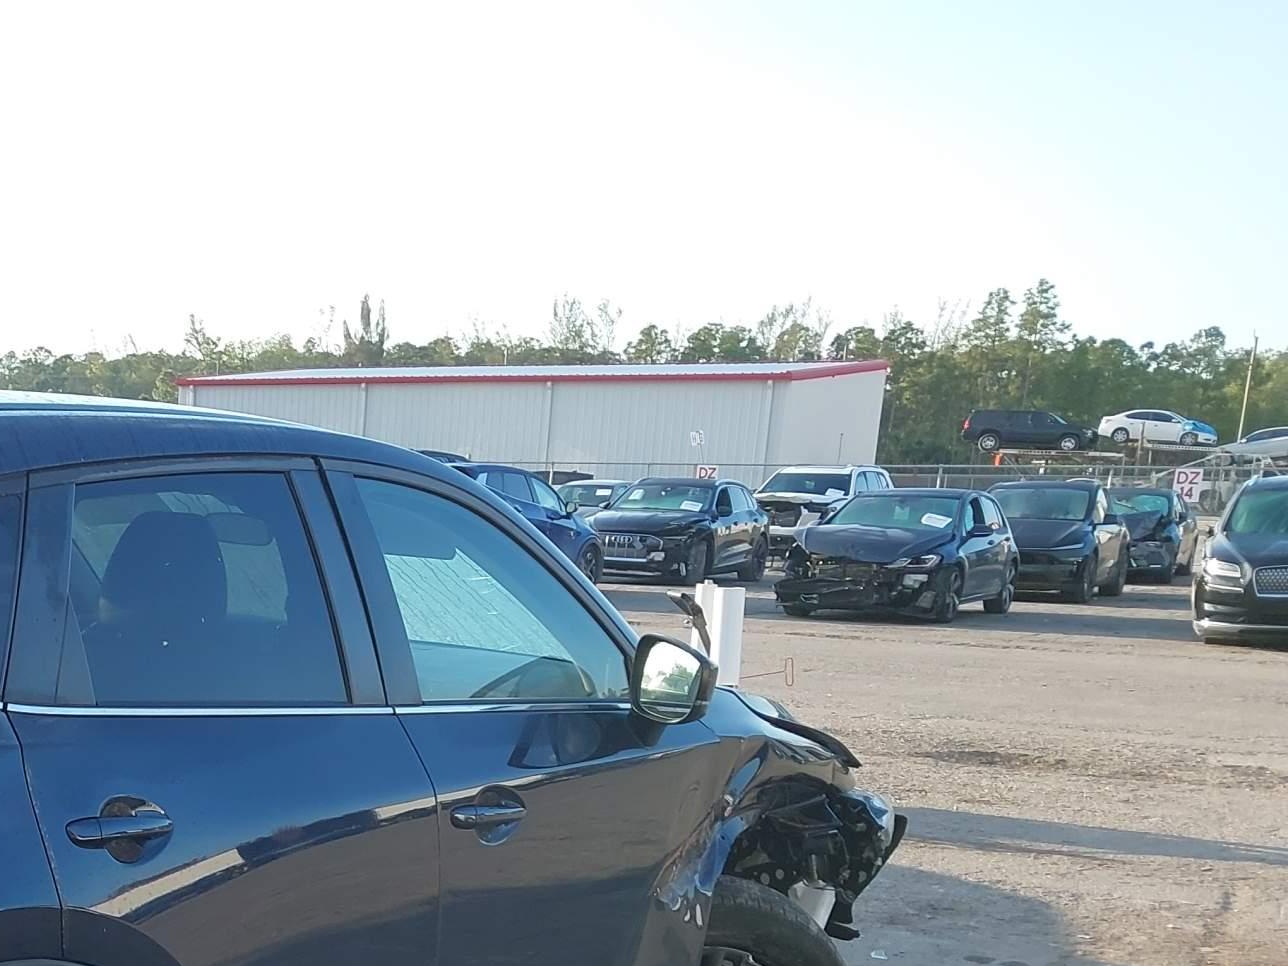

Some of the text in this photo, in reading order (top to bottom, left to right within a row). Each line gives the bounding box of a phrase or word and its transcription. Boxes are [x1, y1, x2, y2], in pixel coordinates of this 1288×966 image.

[699, 467, 717, 479] DZ
[1176, 471, 1201, 484] DZ
[1179, 486, 1194, 500] 14
